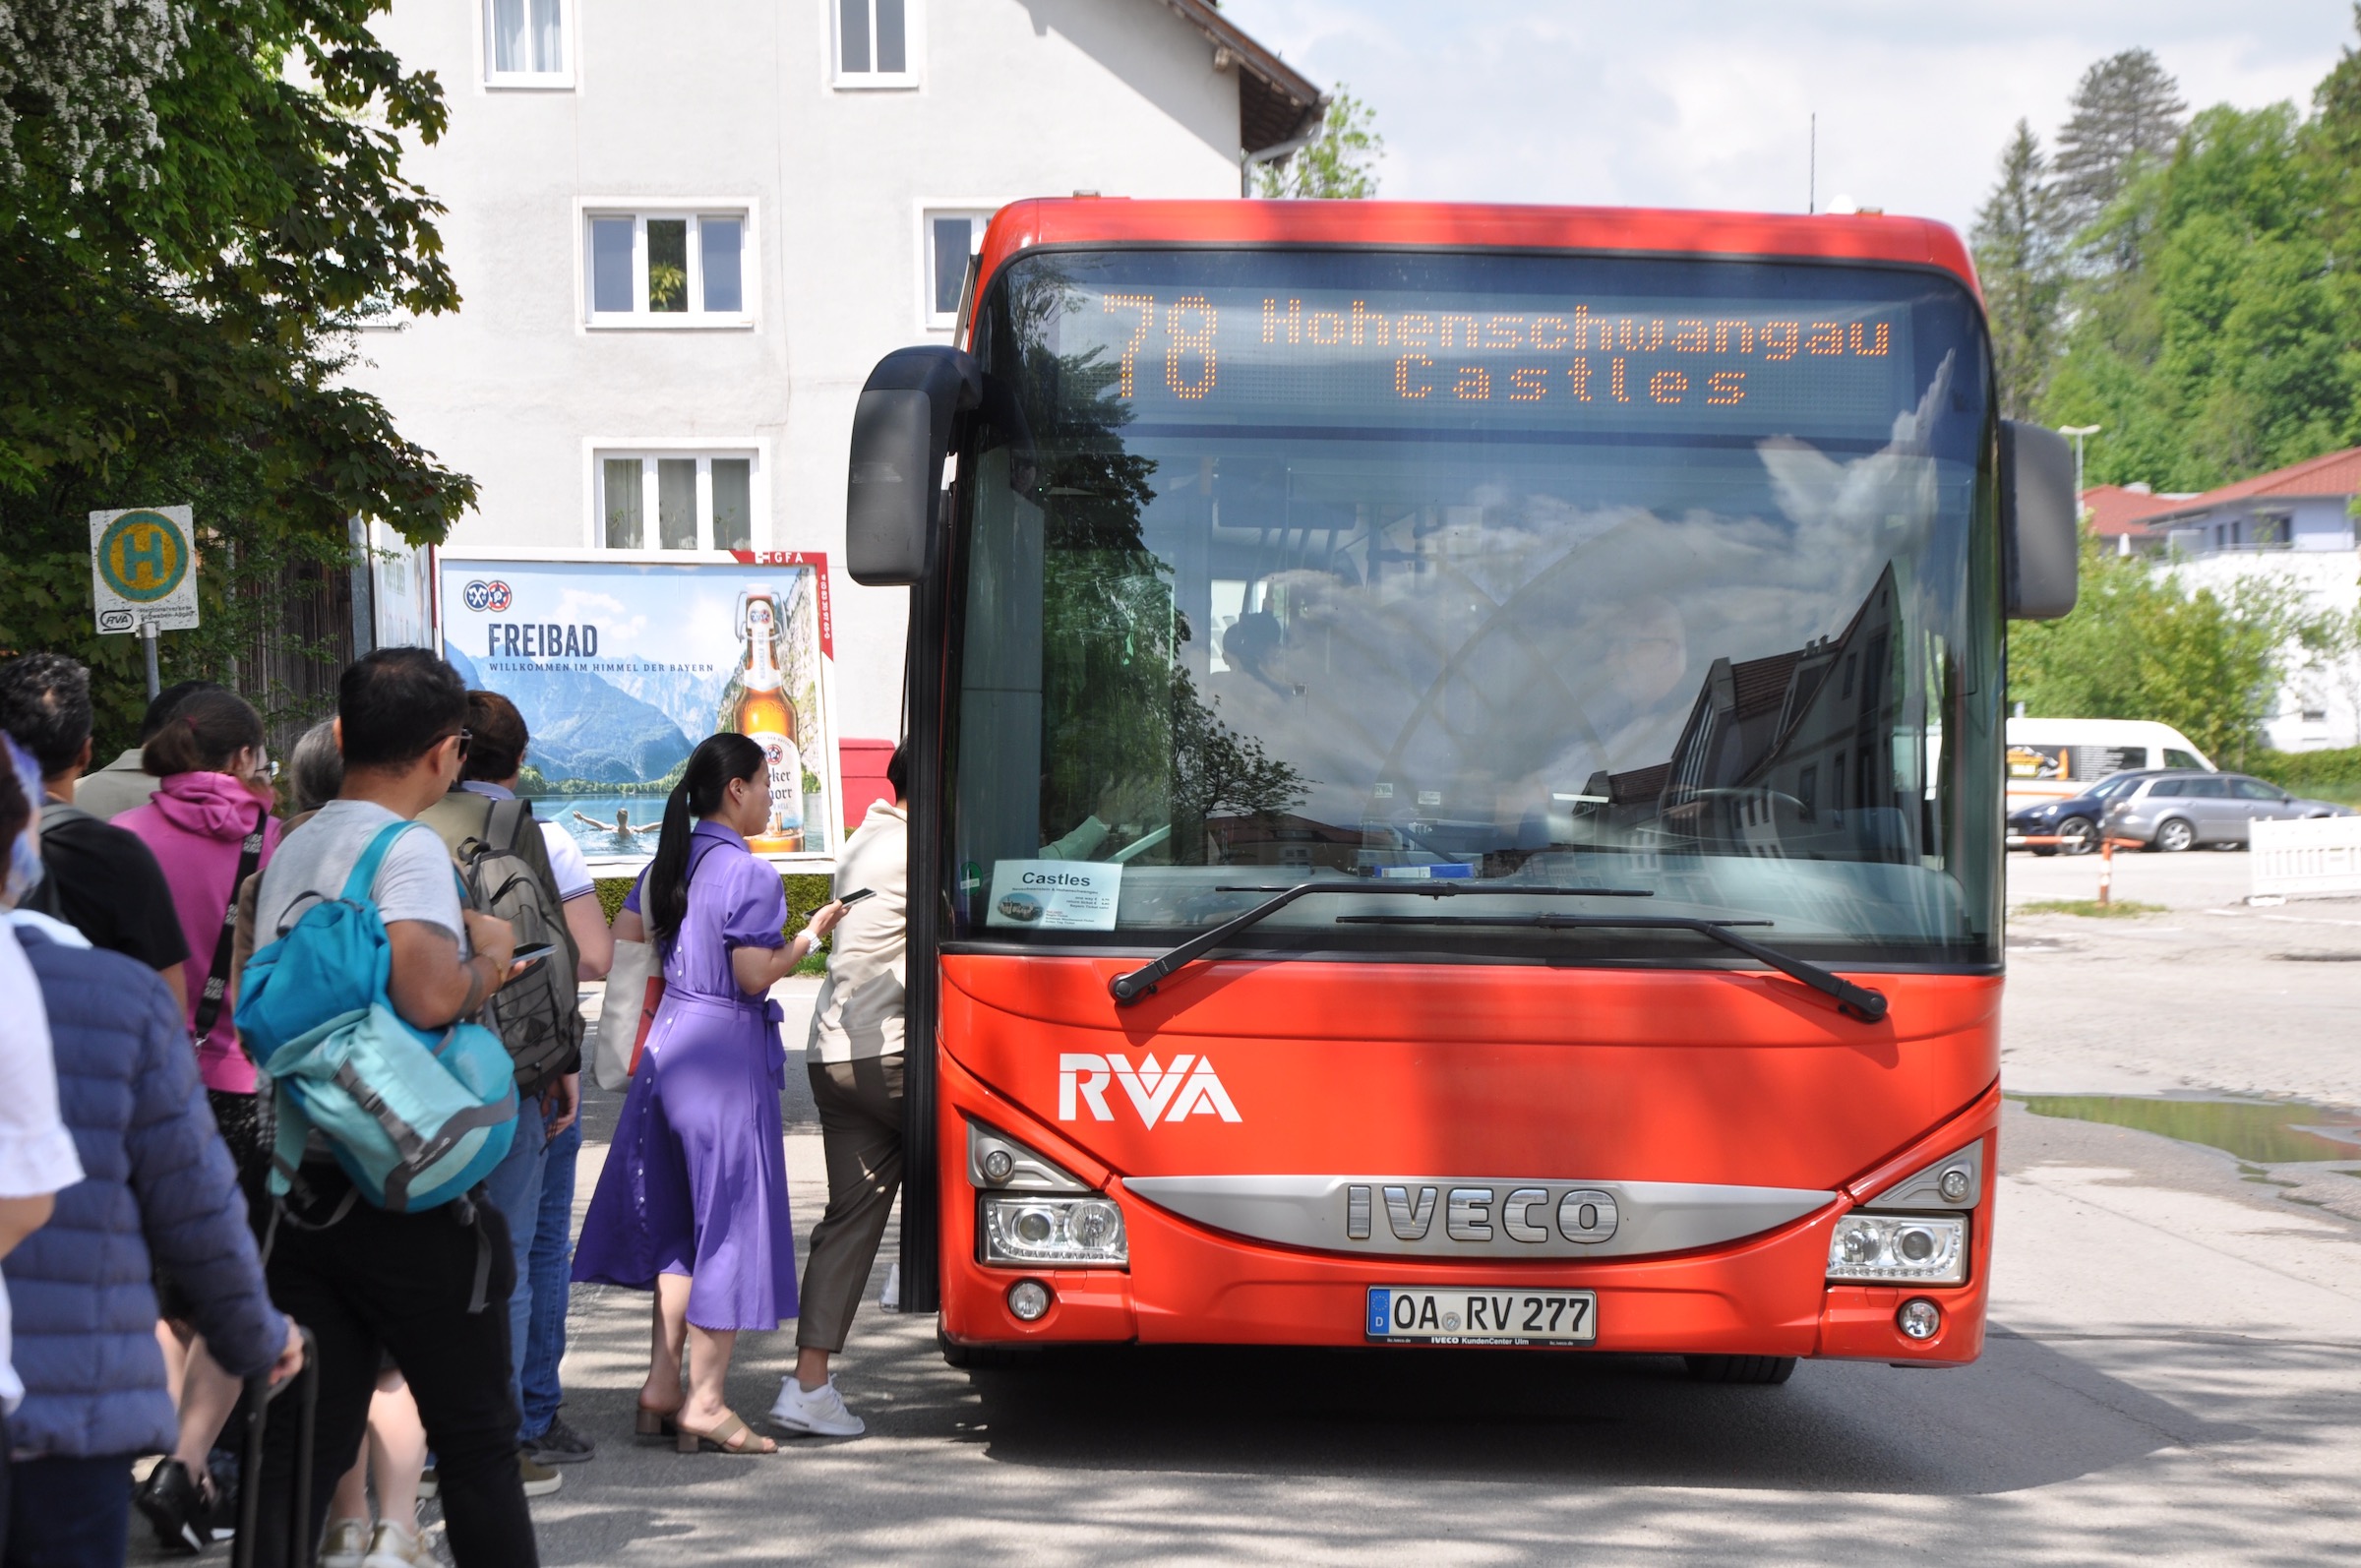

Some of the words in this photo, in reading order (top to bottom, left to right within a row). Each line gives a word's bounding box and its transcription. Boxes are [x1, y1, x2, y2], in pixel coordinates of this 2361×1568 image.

[1104, 294, 1218, 399] 78
[1261, 298, 1890, 361] Hohenschwangau
[1395, 353, 1746, 404] Castles
[123, 532, 164, 580] H
[774, 552, 804, 564] GFA
[105, 615, 129, 625] RVA
[488, 623, 598, 658] FREIBAD
[489, 662, 570, 672] WILLKOMMEN
[575, 663, 588, 672] IM
[592, 663, 638, 672] HIMMEL
[643, 663, 665, 672] DER
[670, 663, 713, 672] BAYERN
[1022, 872, 1091, 887] Castles
[1059, 1052, 1243, 1131] RVA
[1346, 1184, 1619, 1244] IVECO
[1375, 1316, 1384, 1328] D
[1394, 1294, 1439, 1330] OA
[1467, 1297, 1513, 1330] RV
[1523, 1297, 1590, 1332] 277
[1430, 1336, 1459, 1345] IVECO
[1461, 1337, 1512, 1346] KundenCenter
